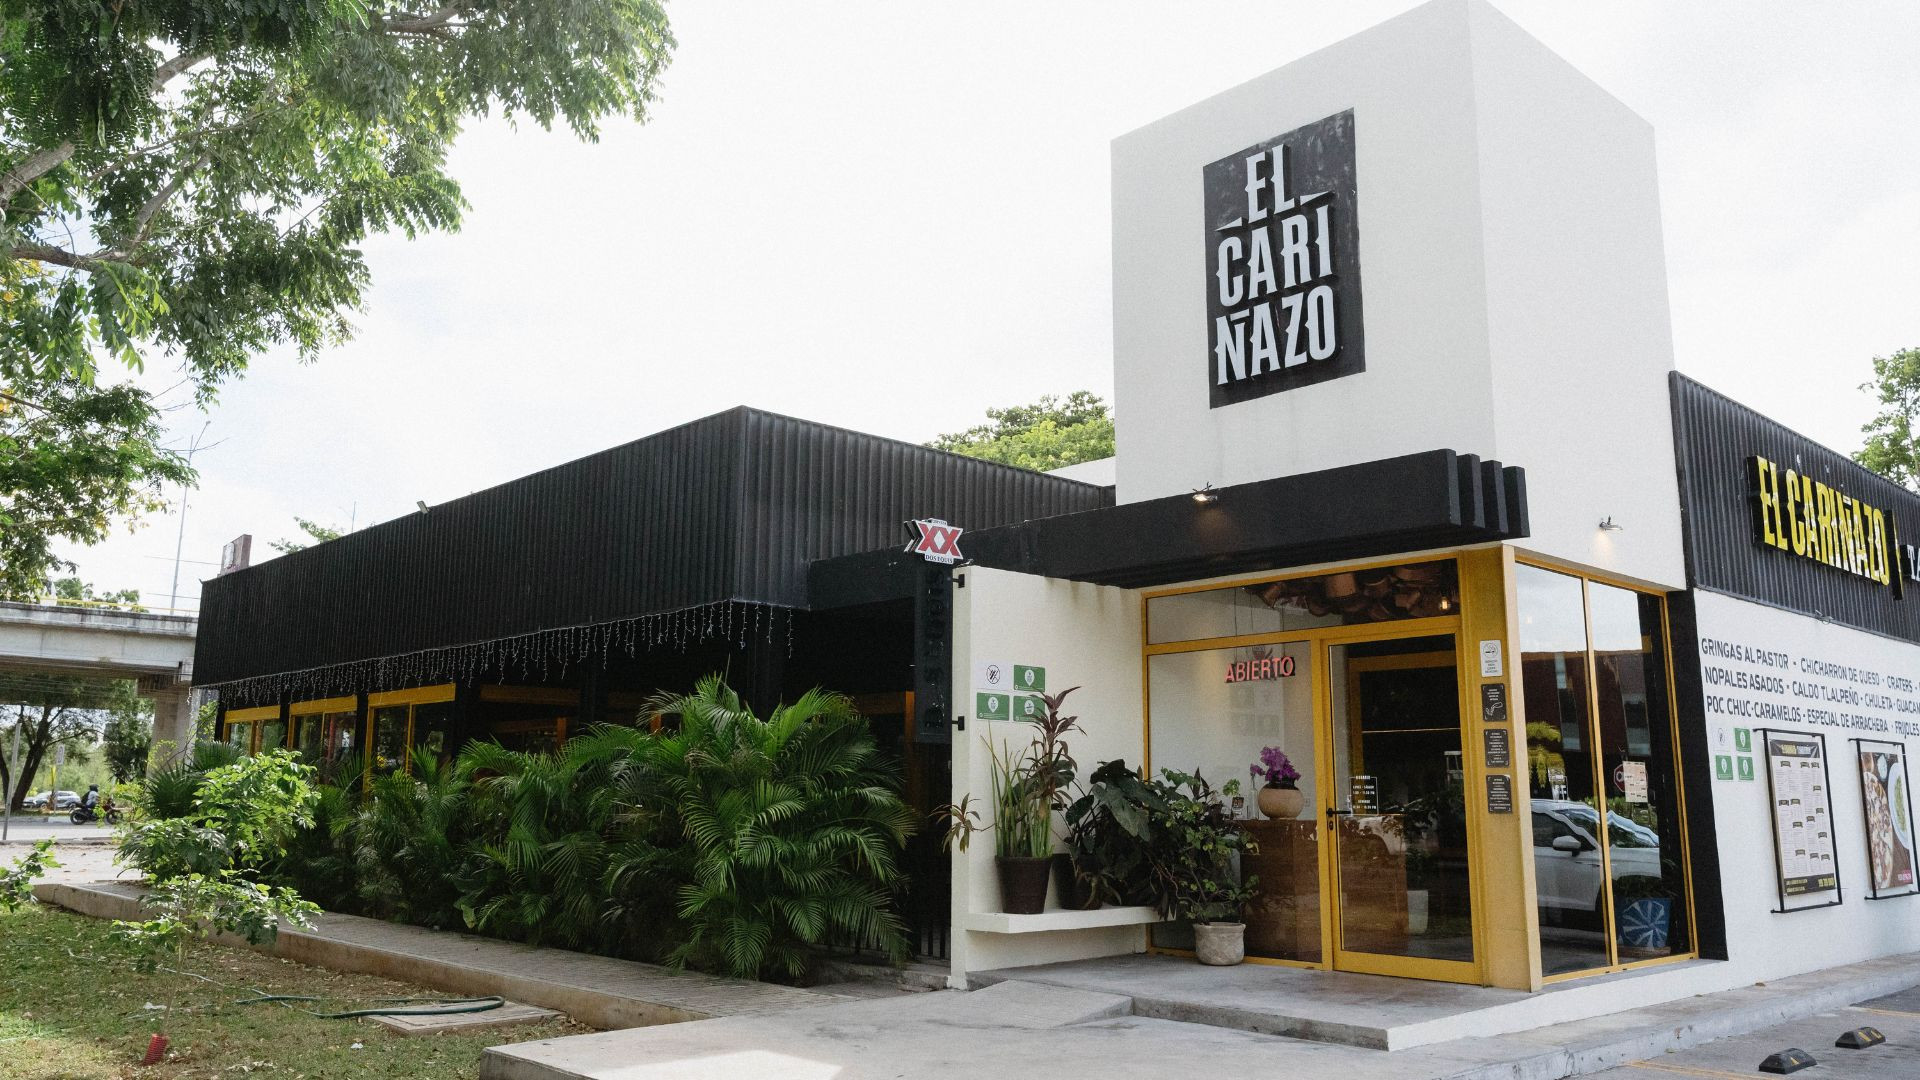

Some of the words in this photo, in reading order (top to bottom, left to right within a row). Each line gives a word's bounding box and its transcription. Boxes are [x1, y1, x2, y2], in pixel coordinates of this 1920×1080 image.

[1244, 143, 1295, 223] EL
[1216, 204, 1332, 307] CARI
[1214, 285, 1336, 385] ÑAZO
[917, 522, 962, 557] XX
[1757, 455, 1788, 551] EL
[1785, 468, 1890, 586] CARIÑAZO
[1224, 655, 1294, 683] ABIERTO
[1701, 638, 1743, 661] GRINGAS
[1744, 646, 1756, 664] AL
[1756, 649, 1788, 670] PASTOR
[1800, 657, 1848, 681] CHICHARRON
[1848, 667, 1858, 682] DE
[1859, 669, 1880, 686] QUESO
[1704, 665, 1748, 690] NOPALES
[1749, 673, 1784, 695] ASADOS
[1792, 681, 1819, 700] CALDO
[1864, 692, 1893, 711] CHULETA
[1706, 695, 1725, 714] POC
[1753, 702, 1801, 723] CARAMELOS
[1807, 708, 1840, 727] ESPECIAL
[1840, 712, 1850, 728] DE
[1850, 714, 1889, 732] ARRACHERA
